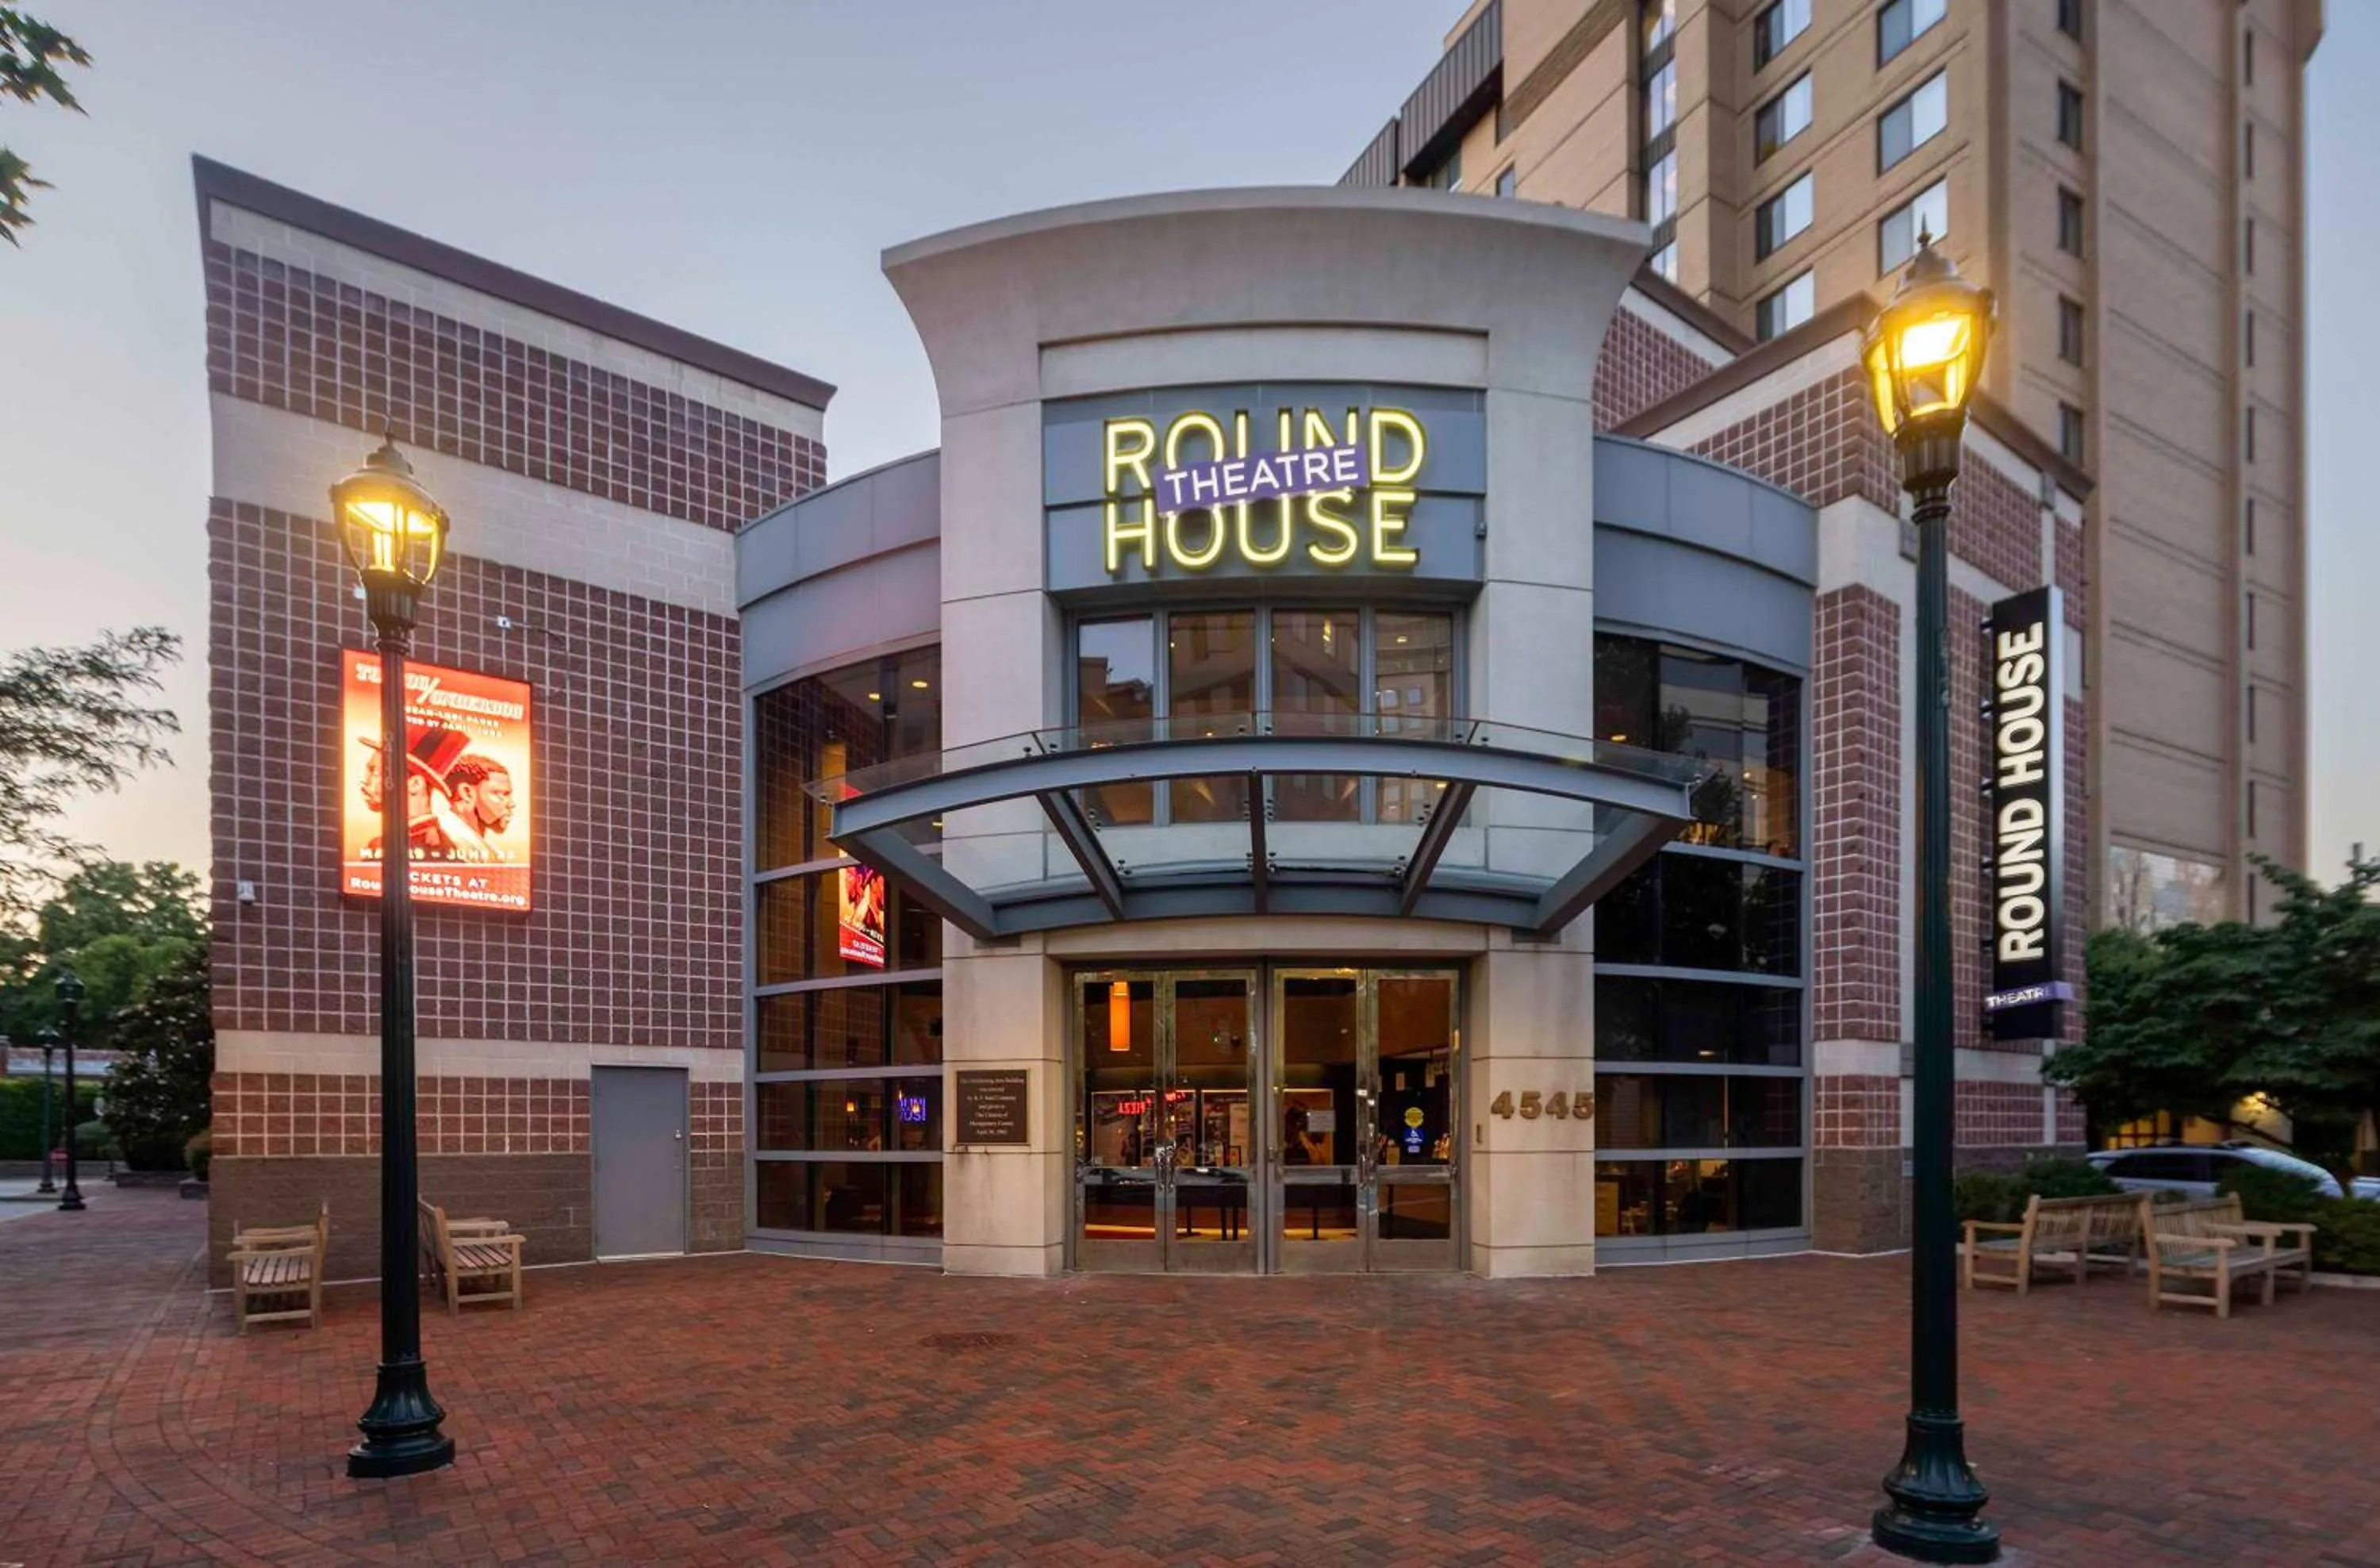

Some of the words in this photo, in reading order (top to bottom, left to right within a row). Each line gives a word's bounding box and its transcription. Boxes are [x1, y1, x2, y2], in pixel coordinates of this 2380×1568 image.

[1104, 406, 1426, 495] ROUND
[1164, 448, 1359, 505] THEATRE
[1105, 490, 1419, 573] HOUSE
[1997, 621, 2044, 788] HOUSE
[359, 847, 382, 859] MA
[409, 872, 462, 886] CKETS
[468, 878, 488, 889] AT
[1998, 797, 2044, 962] ROUND
[1491, 1090, 1595, 1120] 4545
